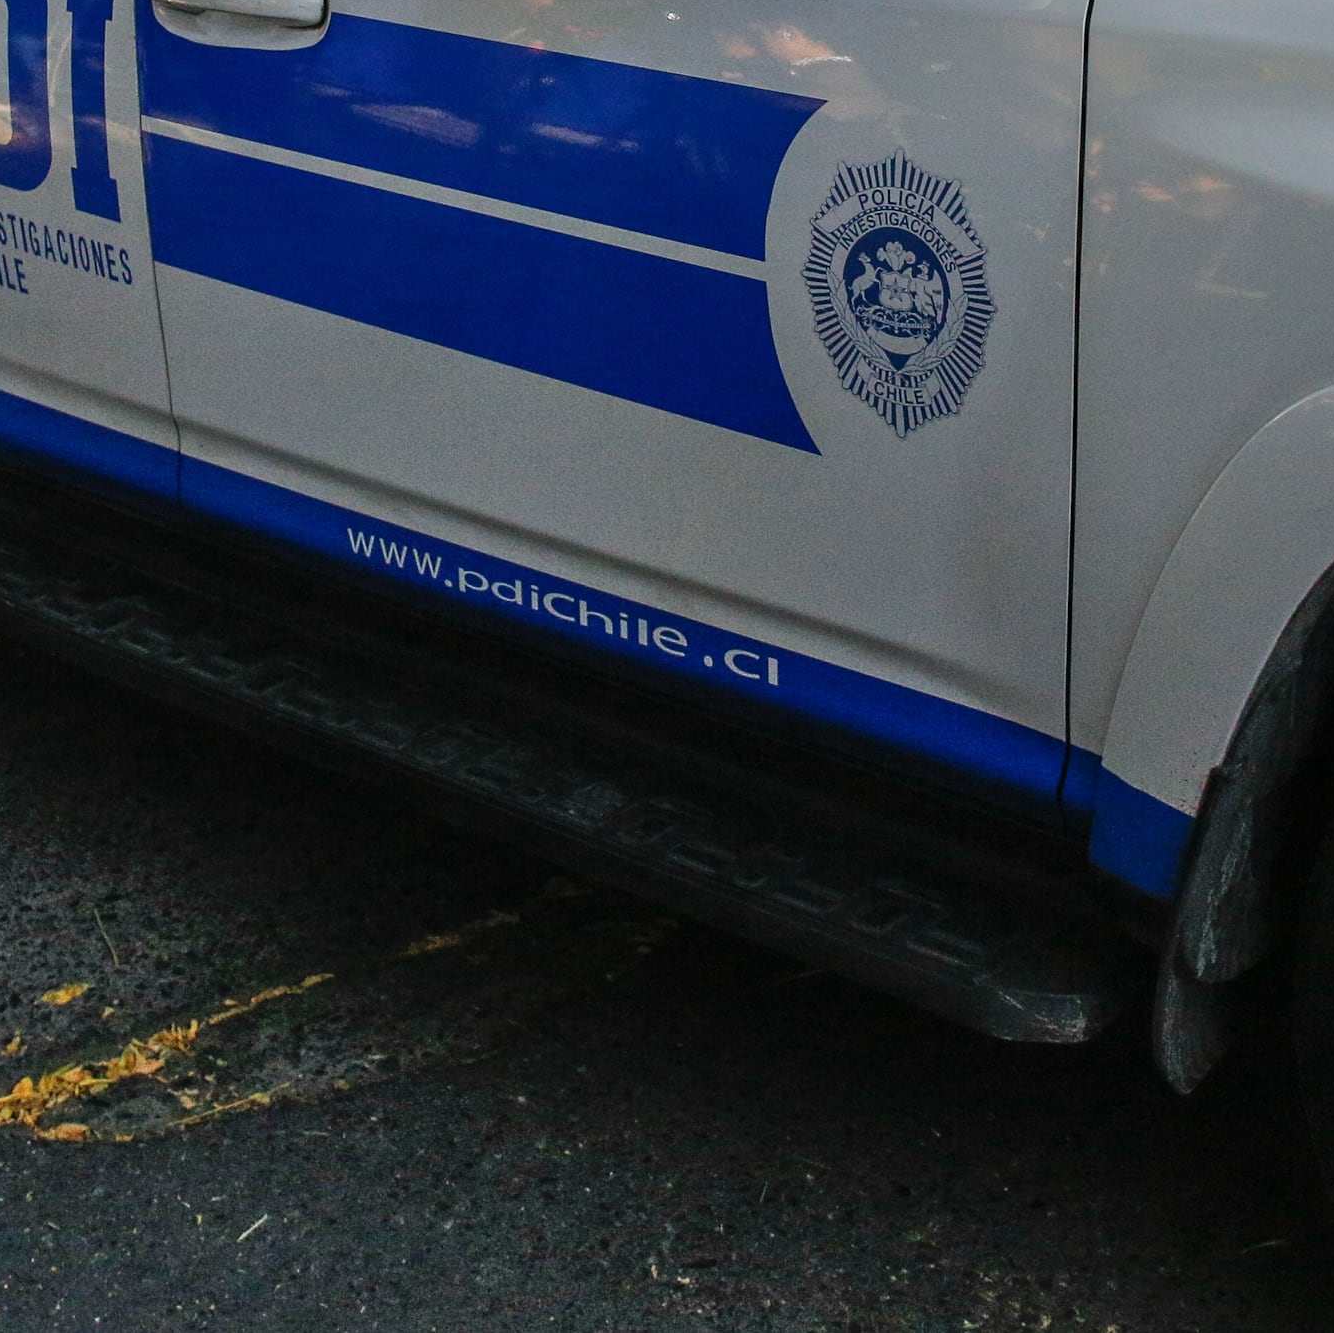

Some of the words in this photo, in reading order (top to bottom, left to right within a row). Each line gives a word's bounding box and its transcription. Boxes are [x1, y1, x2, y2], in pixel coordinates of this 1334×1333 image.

[858, 189, 936, 222] POLICIA
[839, 212, 957, 274] INVESTIGACIONES
[874, 381, 925, 405] CHILE
